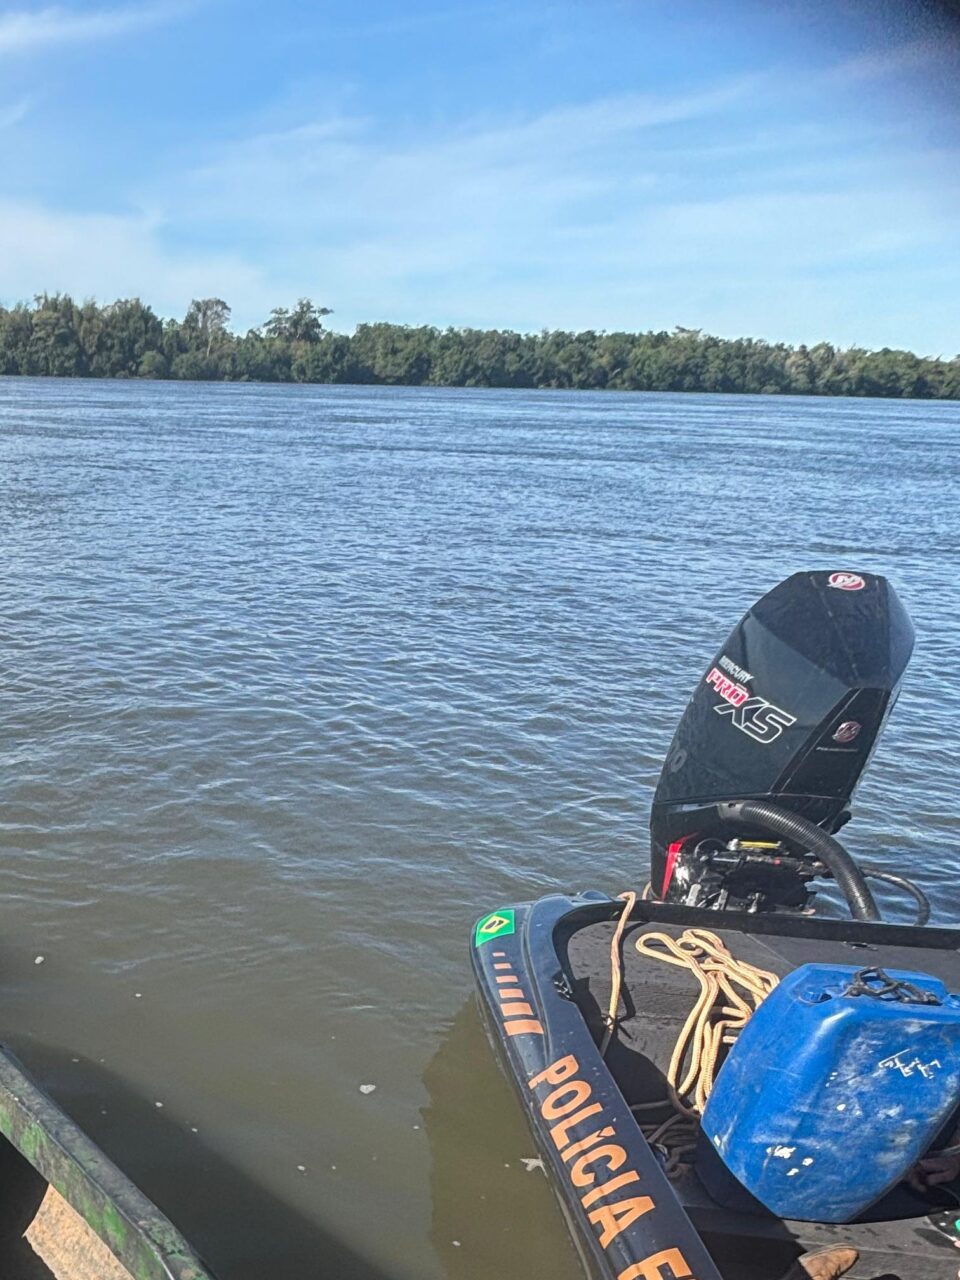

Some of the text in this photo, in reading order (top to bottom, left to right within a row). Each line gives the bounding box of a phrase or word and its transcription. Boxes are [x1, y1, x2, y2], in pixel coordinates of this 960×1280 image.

[706, 667, 797, 743] PRO XS
[719, 655, 754, 683] MERCURY
[529, 1054, 656, 1249] POLÍCIA
